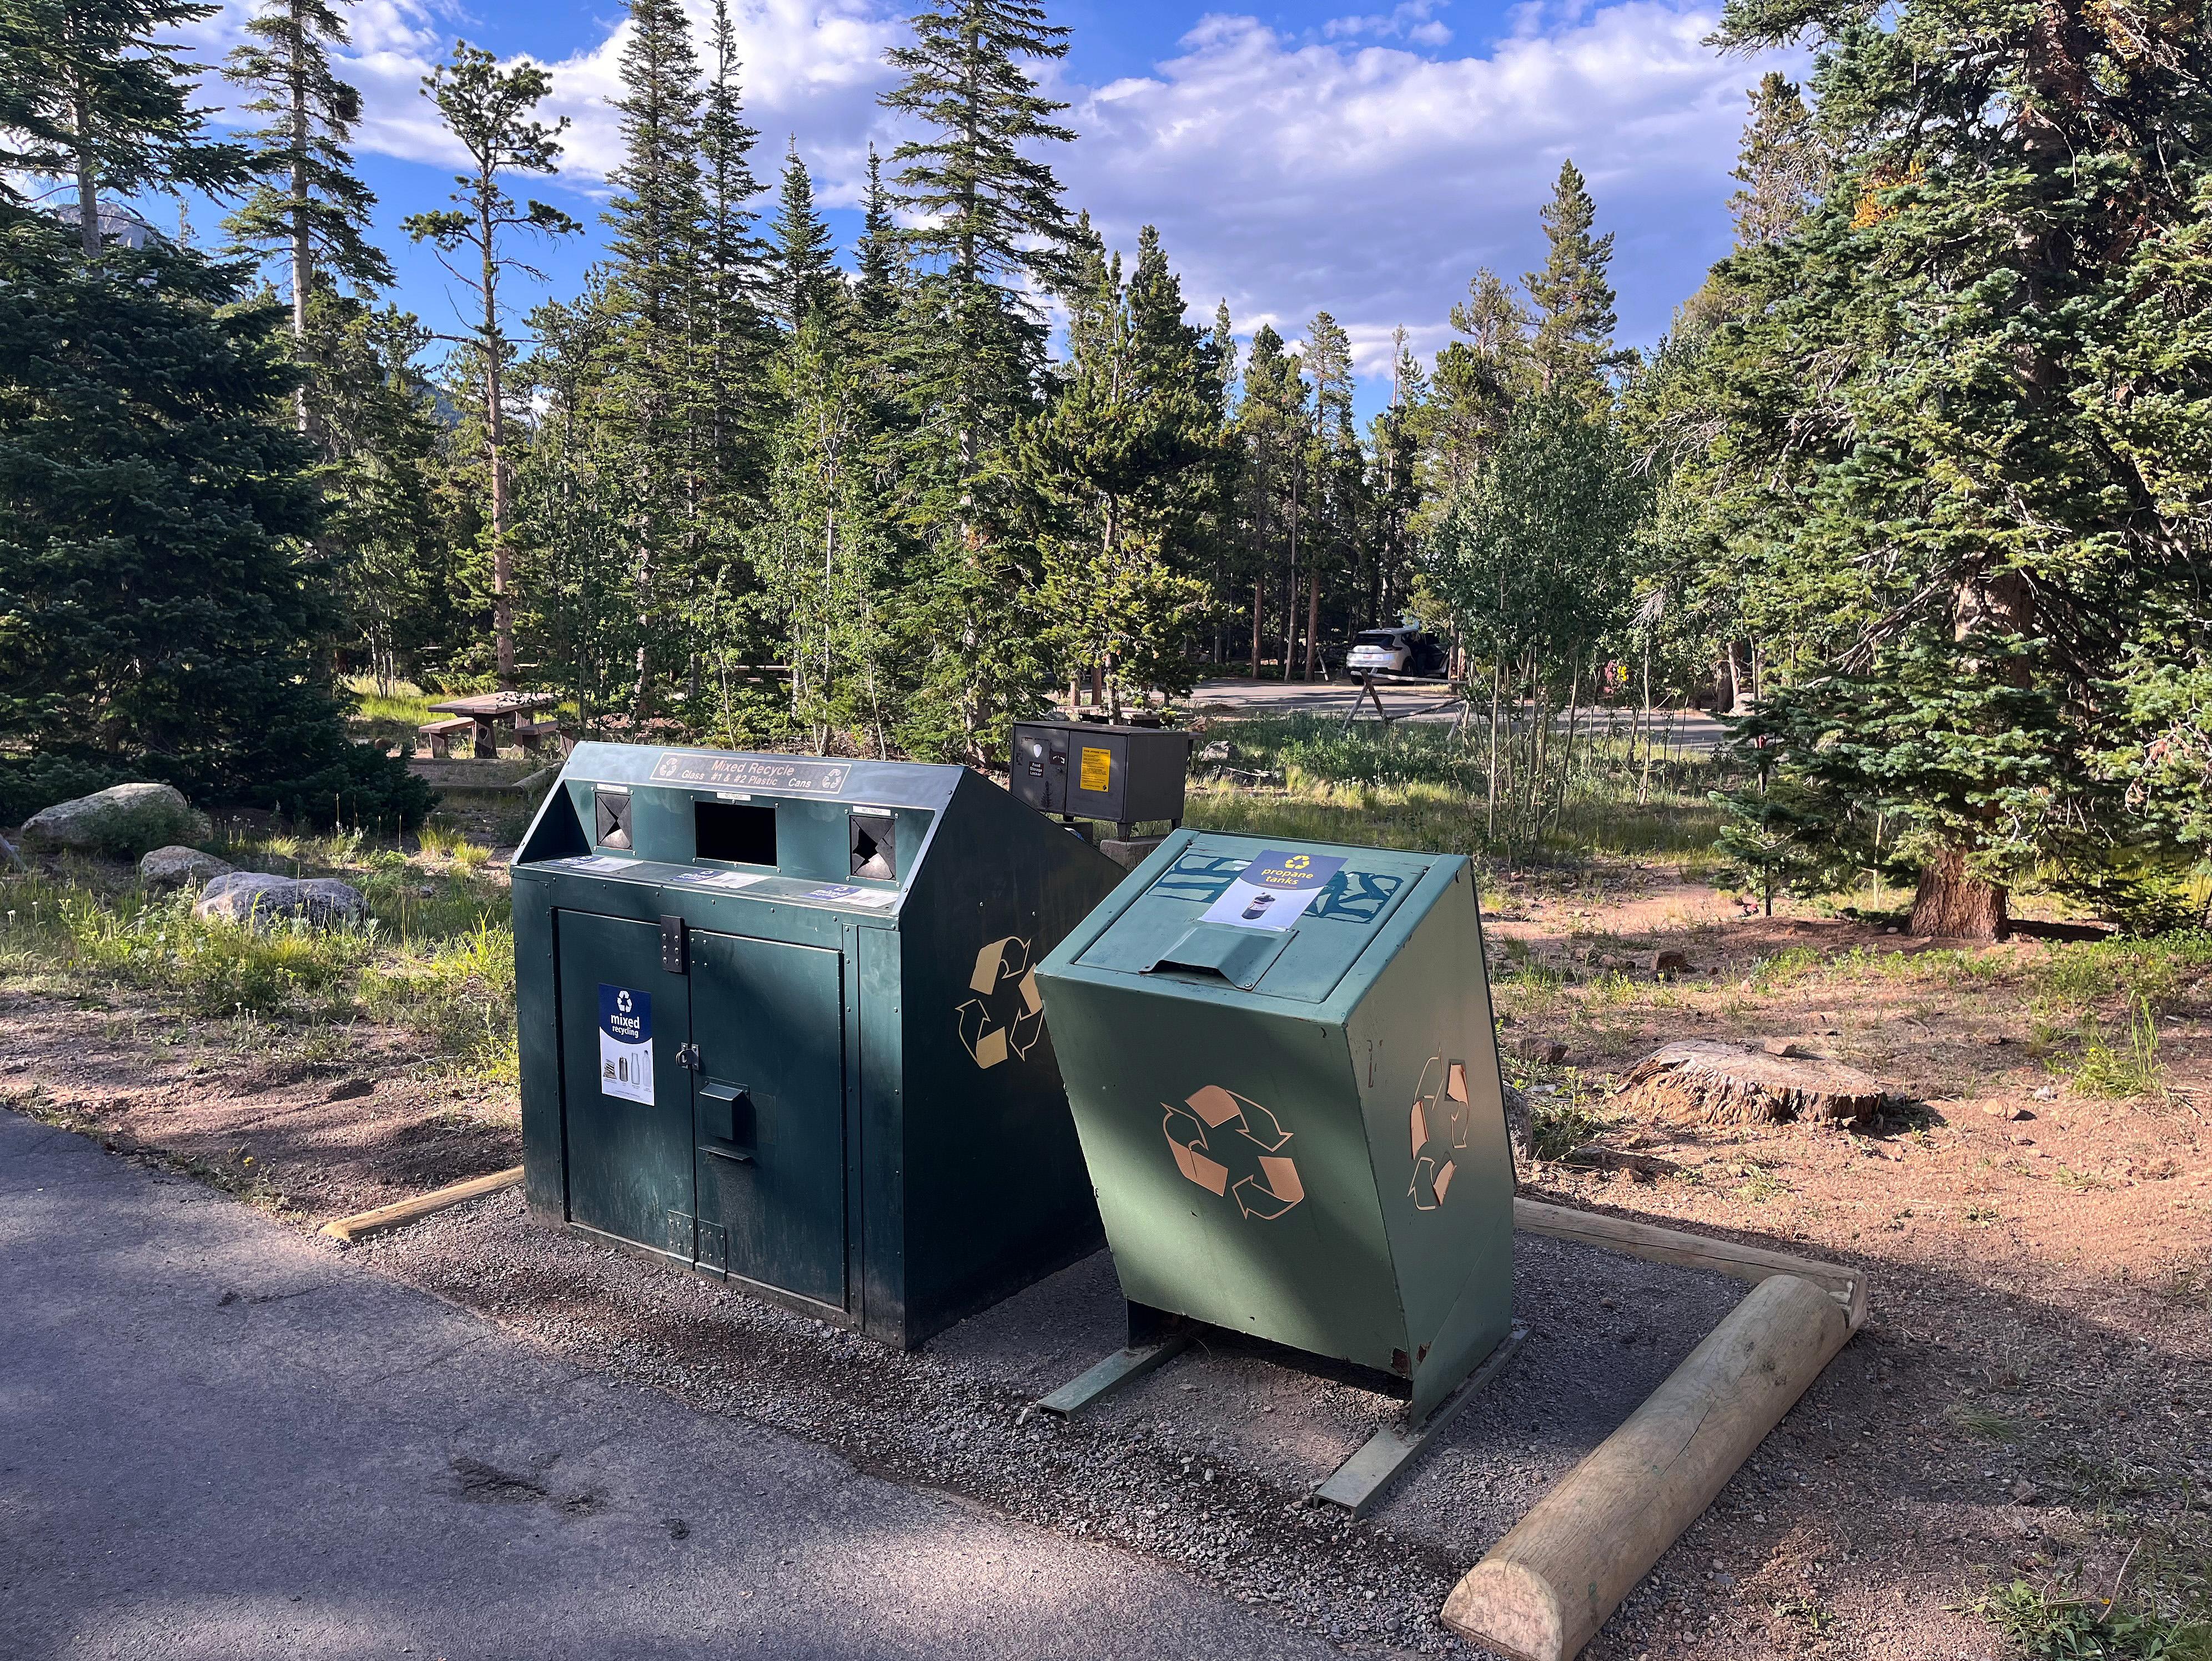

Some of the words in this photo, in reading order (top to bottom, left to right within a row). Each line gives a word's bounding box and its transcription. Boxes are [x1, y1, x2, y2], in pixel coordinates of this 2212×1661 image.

[711, 759, 747, 773] Mixed
[748, 762, 795, 777] Recycle
[681, 769, 705, 780] Glass
[710, 772, 723, 781] #1
[723, 773, 732, 782] &
[733, 774, 747, 783] #2
[748, 775, 778, 786] Plastic
[788, 778, 812, 788] Cans
[1261, 868, 1314, 879] propane
[1265, 875, 1299, 885] tanks
[611, 1013, 640, 1029] mixed
[612, 1025, 639, 1039] recycling
